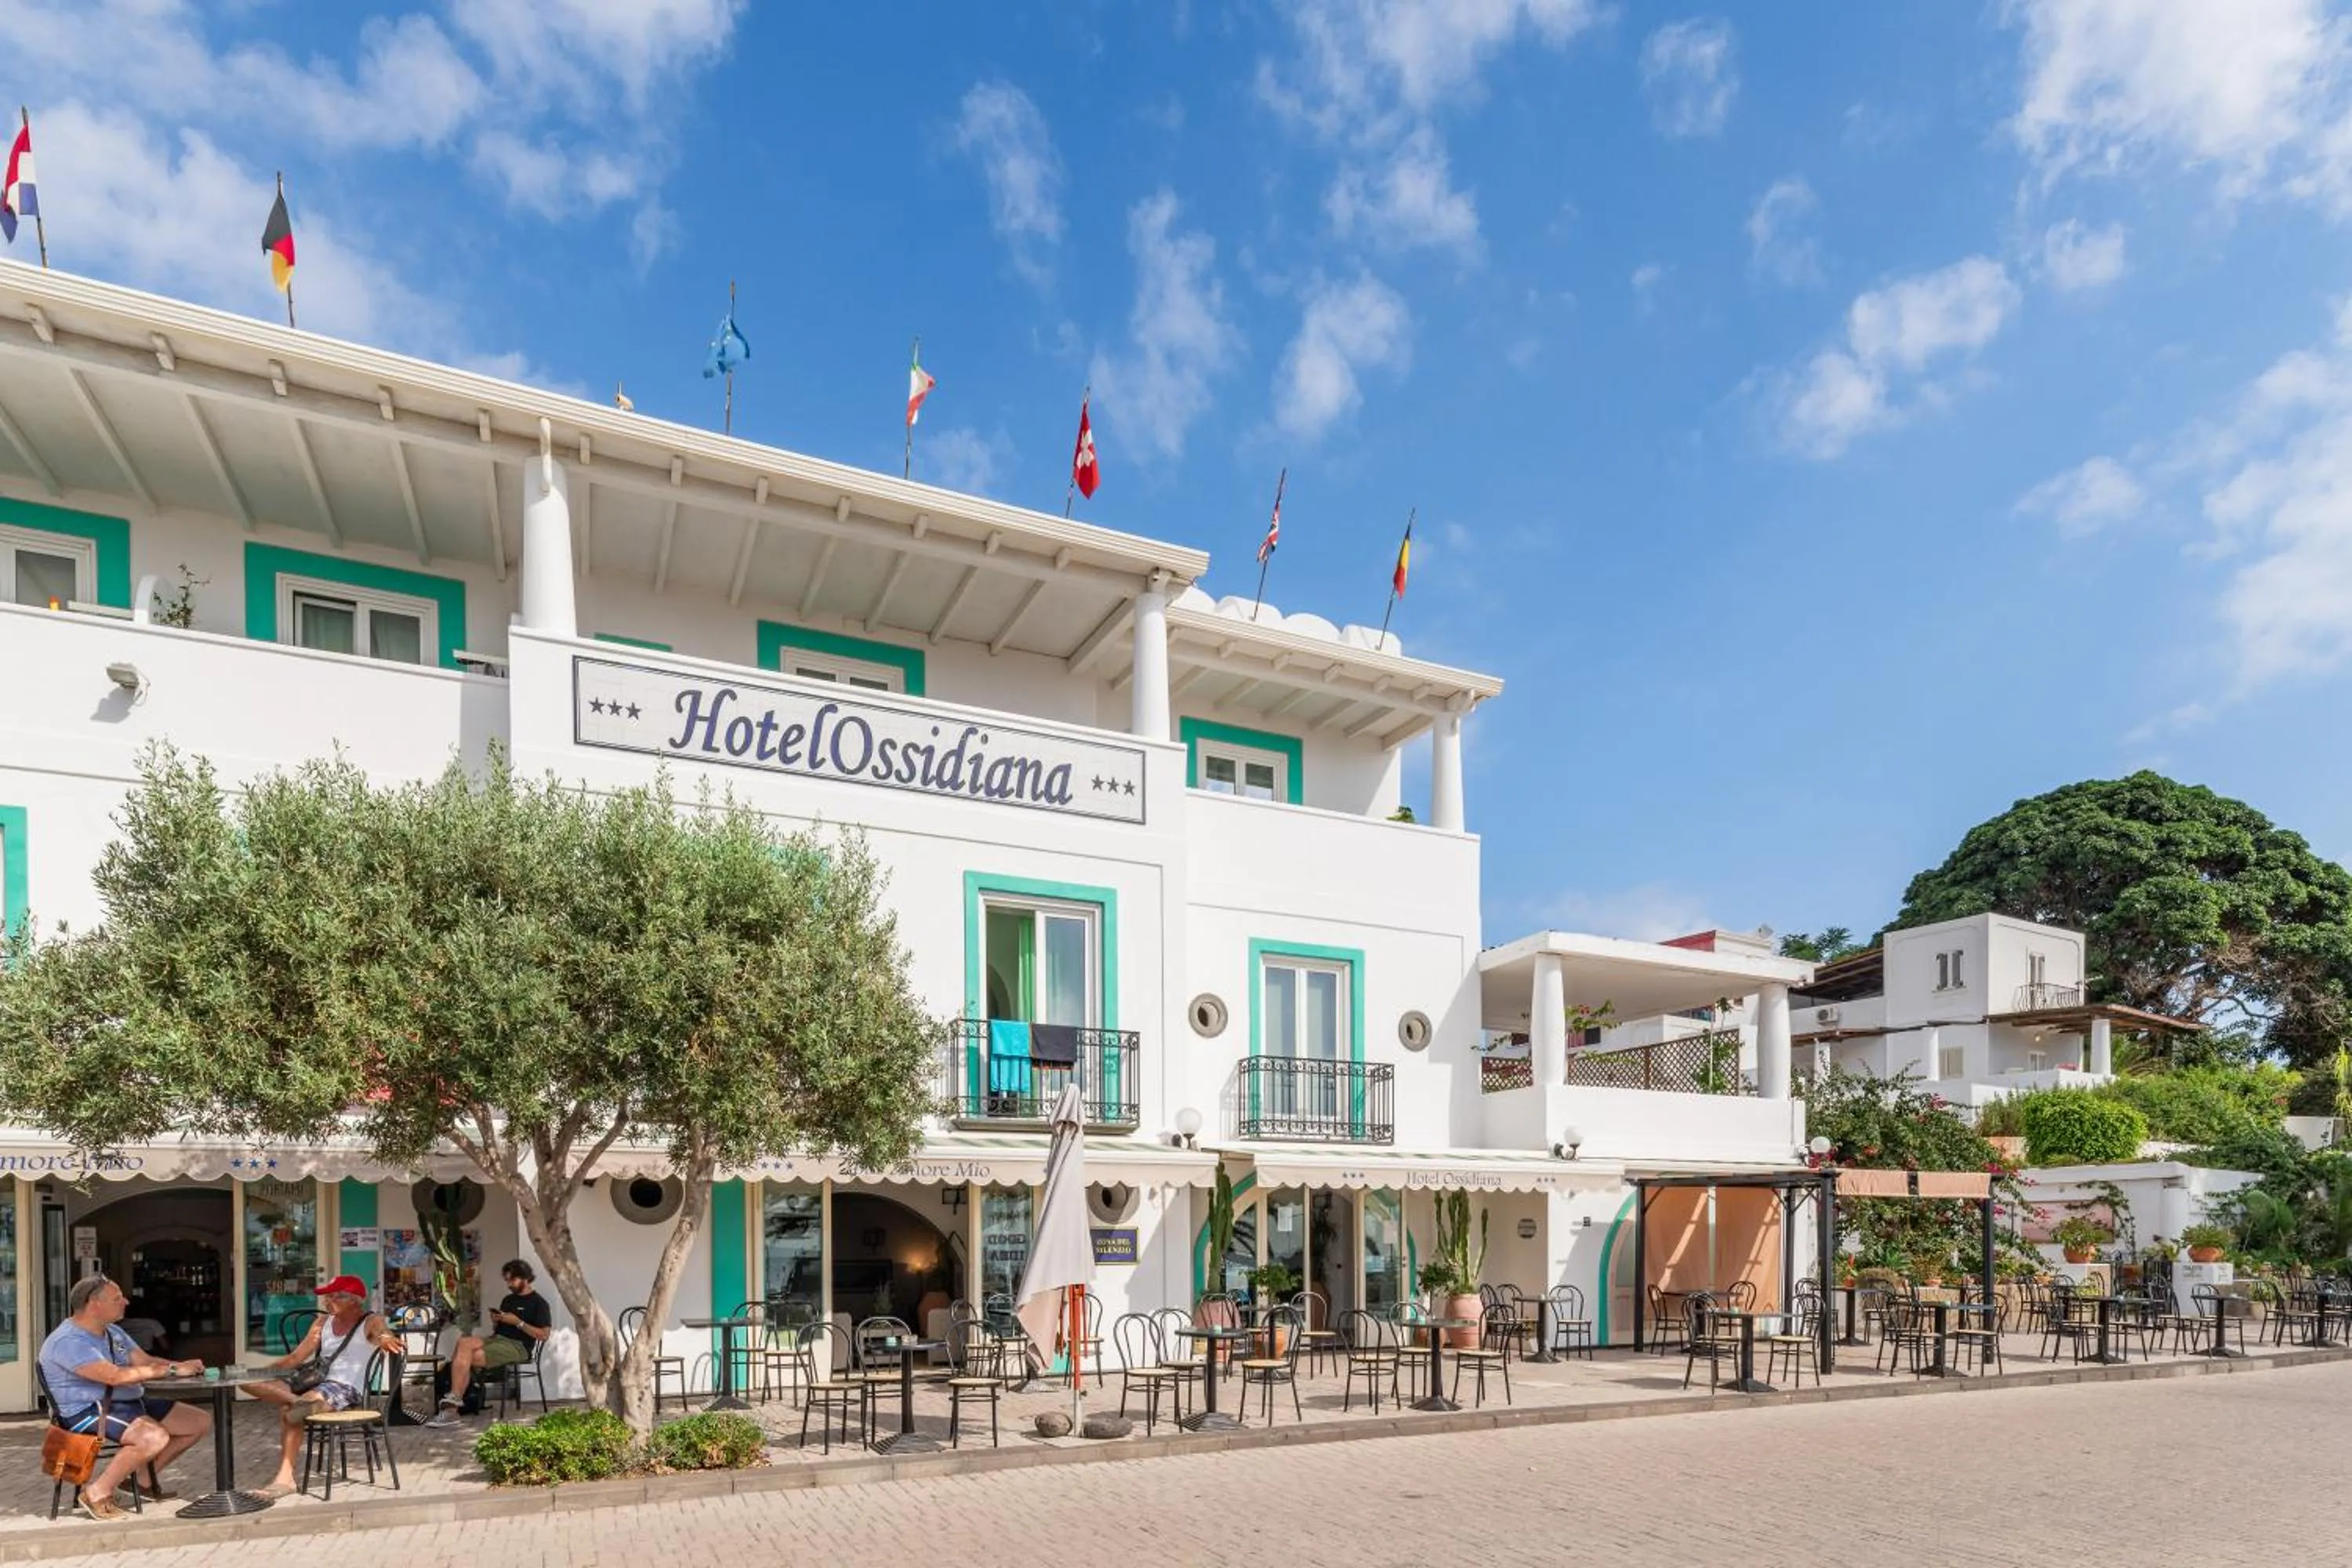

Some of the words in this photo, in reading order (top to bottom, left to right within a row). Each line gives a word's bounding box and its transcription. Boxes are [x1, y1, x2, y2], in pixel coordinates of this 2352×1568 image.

[955, 1161, 990, 1176] Mio
[1407, 1171, 1439, 1184] Hotel
[1443, 1171, 1502, 1185] Ossidiana
